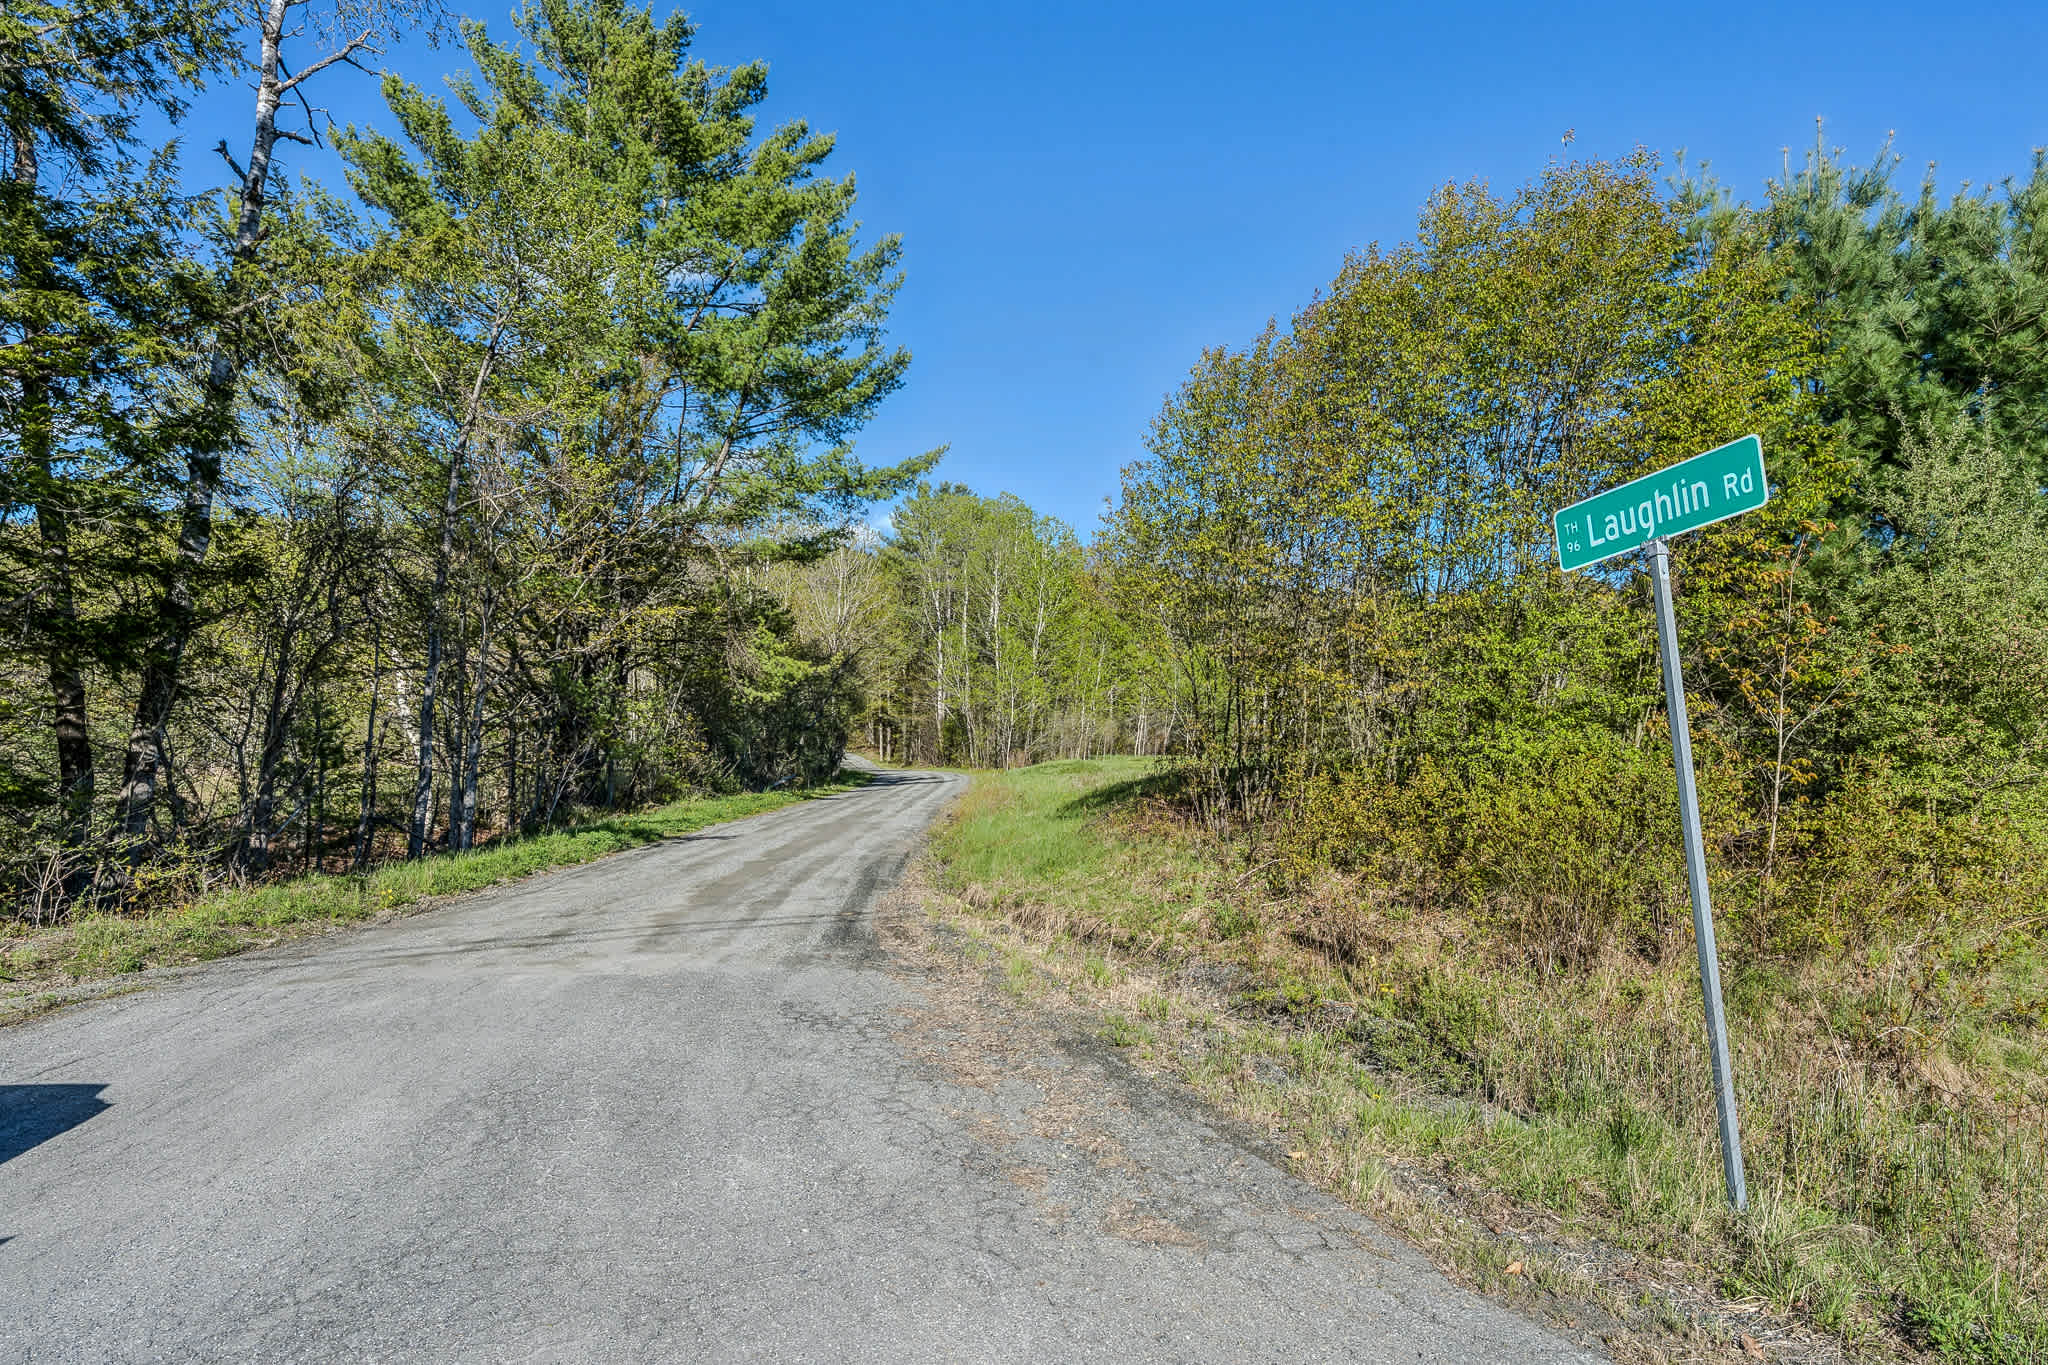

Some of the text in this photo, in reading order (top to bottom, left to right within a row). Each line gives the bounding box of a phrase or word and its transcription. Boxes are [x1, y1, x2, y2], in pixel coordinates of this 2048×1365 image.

[1586, 466, 1753, 547] Laughlin Rd
[1564, 521, 1578, 536] TH
[1566, 540, 1581, 553] 96
